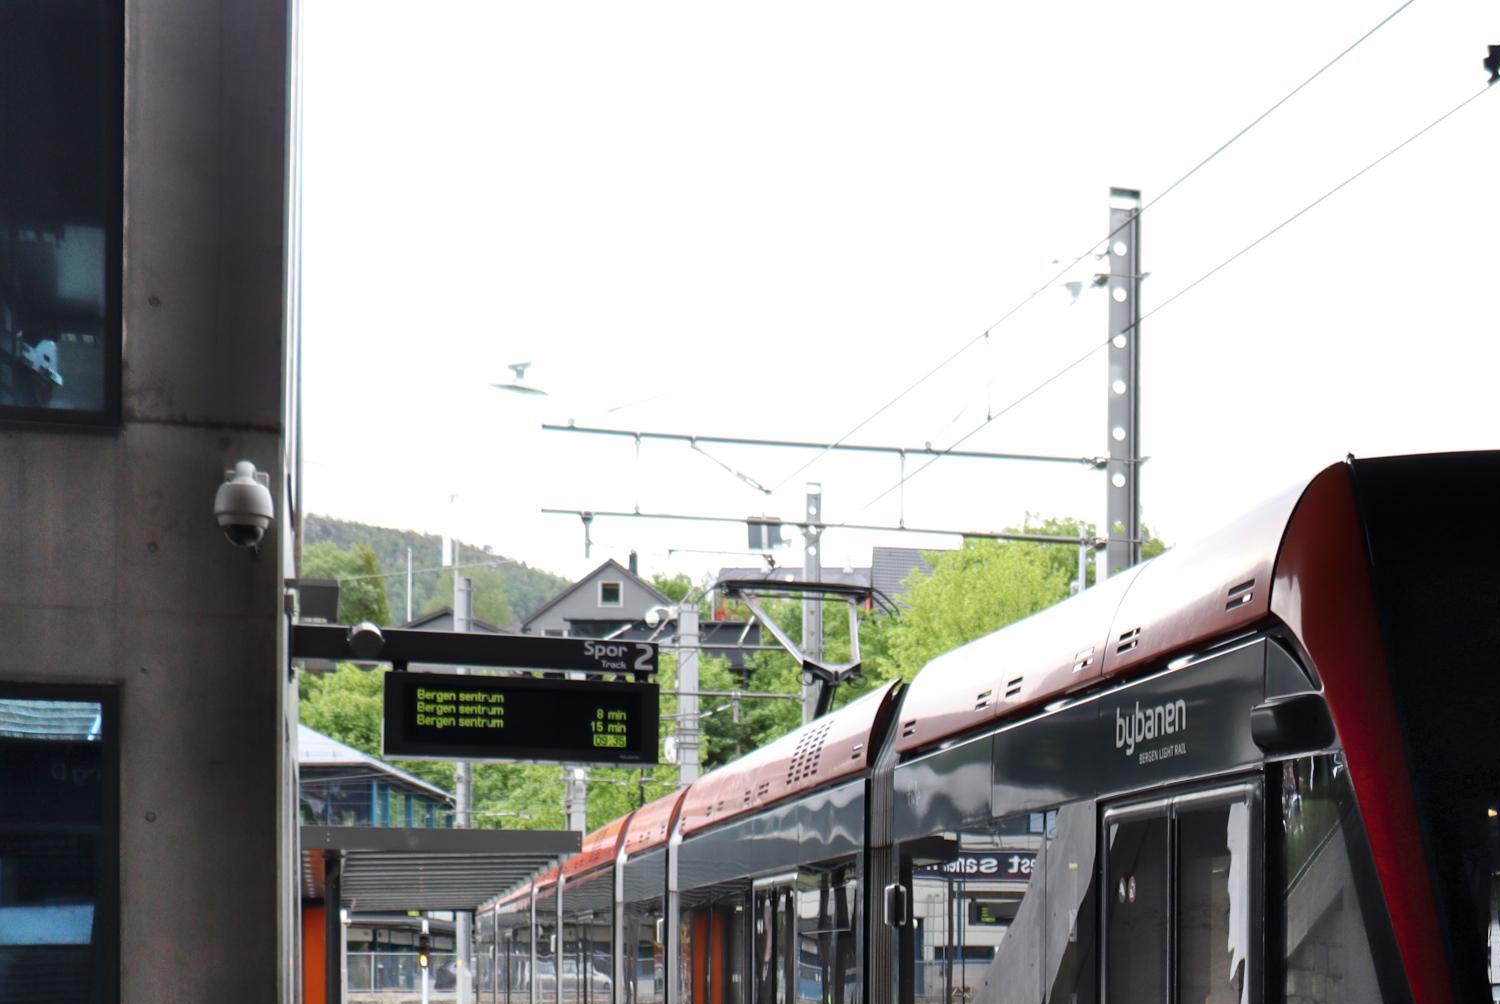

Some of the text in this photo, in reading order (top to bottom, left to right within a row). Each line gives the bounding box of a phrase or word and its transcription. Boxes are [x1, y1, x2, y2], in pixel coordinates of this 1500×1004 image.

[584, 641, 654, 670] Spor 2
[601, 660, 627, 669] Track
[417, 688, 504, 703] Bergen sentrum
[417, 702, 504, 715] Bergen sentrum
[596, 708, 627, 720] 8 min
[417, 714, 504, 728] Bergen sentrum
[590, 721, 627, 733] 15 min
[1115, 699, 1187, 756] bybanen
[1139, 743, 1187, 765] BERGEN LIGHT RAIL
